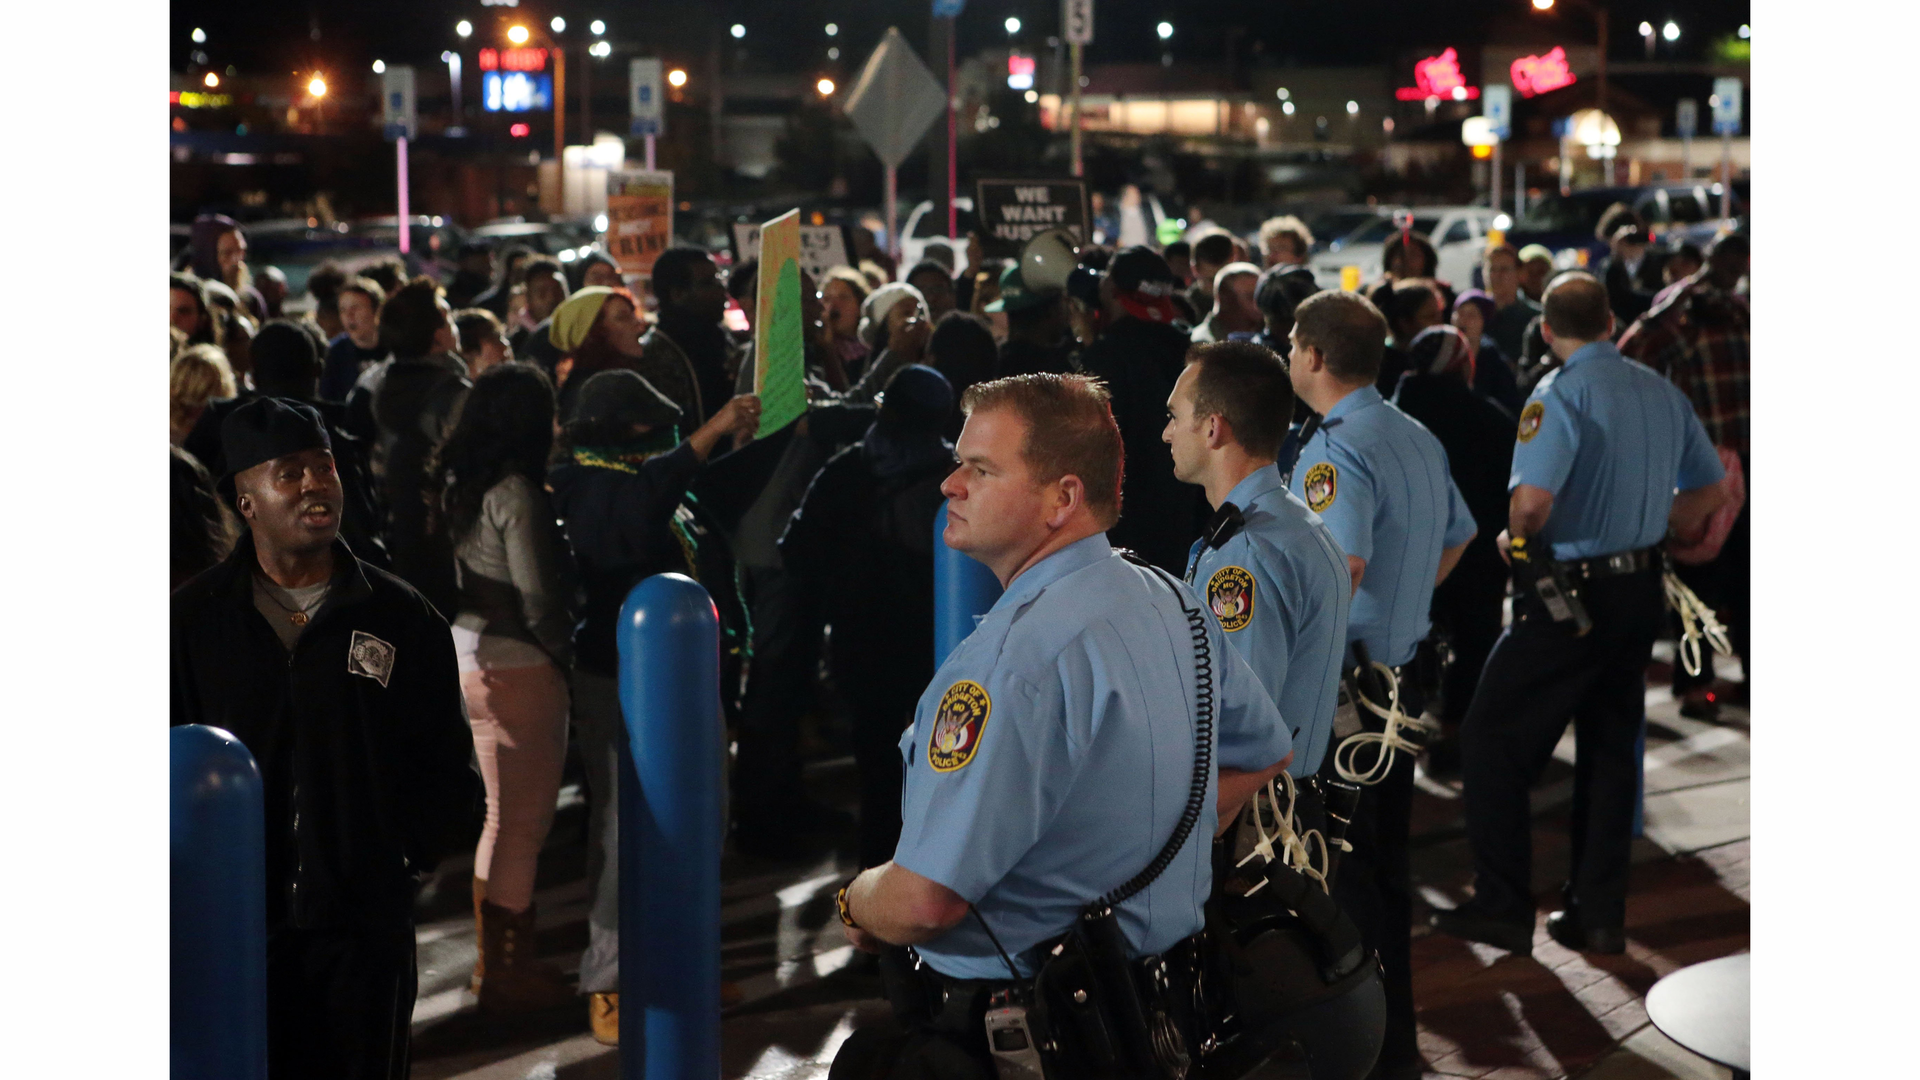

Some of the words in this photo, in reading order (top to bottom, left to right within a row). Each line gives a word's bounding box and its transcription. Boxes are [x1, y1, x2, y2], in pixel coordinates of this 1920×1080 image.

[1014, 187, 1049, 203] WE
[1001, 205, 1066, 222] WANT
[1215, 568, 1230, 580] CITY
[1212, 574, 1248, 592] BRIDGETON
[951, 683, 969, 695] CITY
[969, 685, 982, 697] OF
[942, 692, 982, 716] BRIDGETON
[953, 703, 965, 711] MO
[932, 753, 959, 767] POLICE
